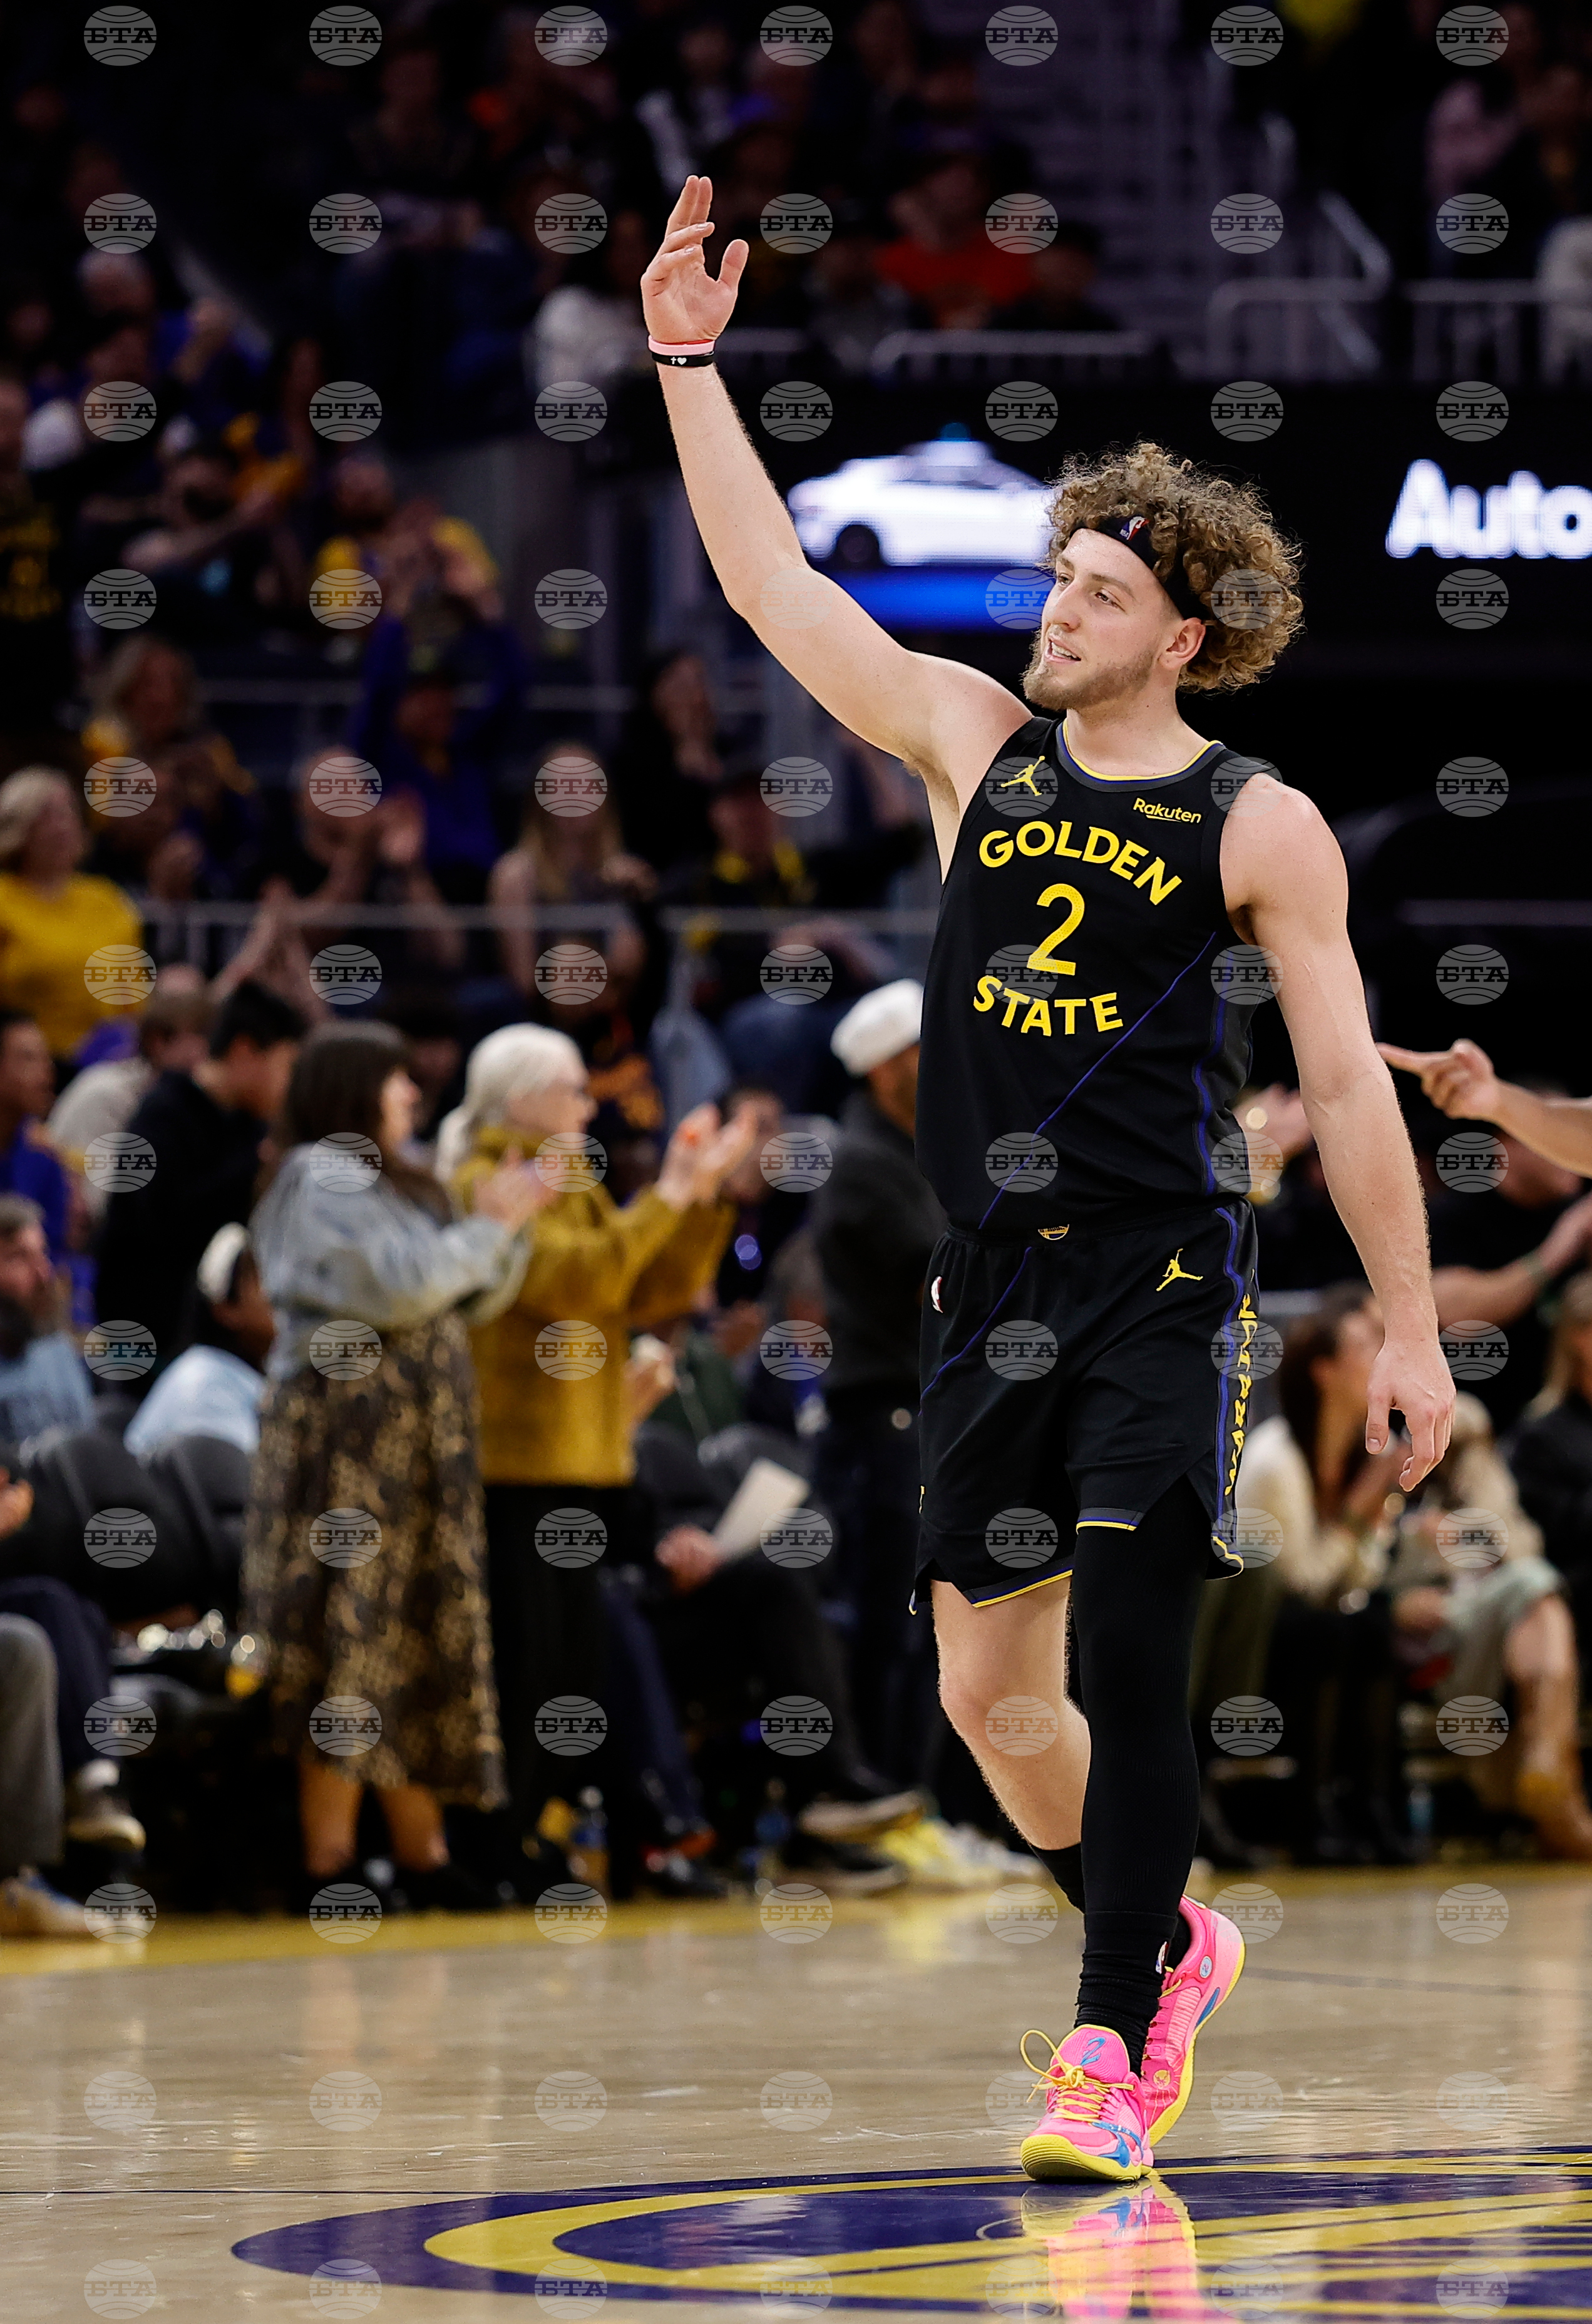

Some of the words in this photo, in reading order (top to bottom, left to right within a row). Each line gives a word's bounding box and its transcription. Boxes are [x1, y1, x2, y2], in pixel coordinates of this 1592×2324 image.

[1385, 458, 1592, 559] Auto
[1132, 797, 1201, 824] Rakuten
[978, 821, 1183, 906] GOLDEN
[1026, 883, 1085, 976] 2
[973, 975, 1124, 1037] STATE
[1224, 1269, 1258, 1496] WARRIOR
